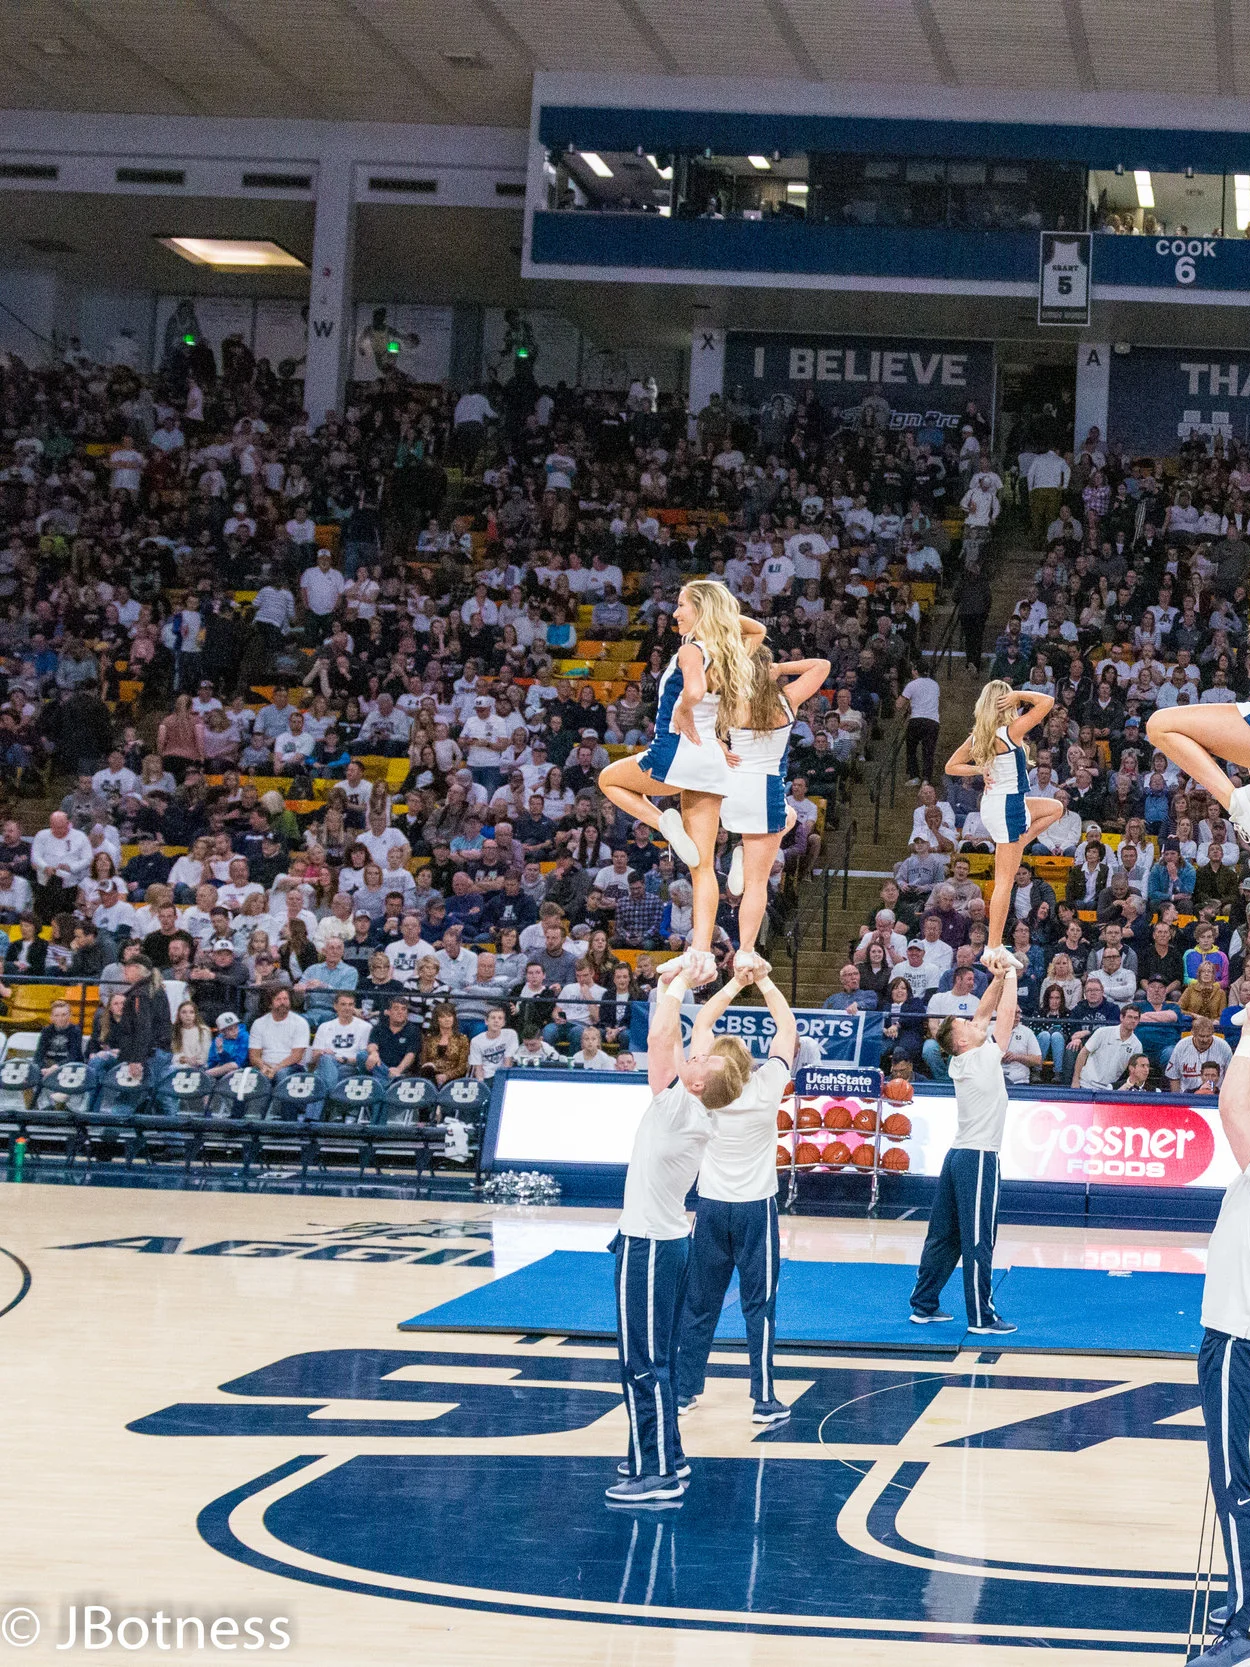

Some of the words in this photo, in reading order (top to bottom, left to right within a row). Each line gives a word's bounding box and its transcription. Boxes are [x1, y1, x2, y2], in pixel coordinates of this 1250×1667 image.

[1155, 240, 1217, 258] COOK
[1174, 256, 1196, 284] 6
[1057, 275, 1072, 295] 5
[314, 321, 334, 338] W
[701, 334, 715, 350] X
[753, 347, 765, 378] I
[788, 347, 969, 386] BELIEVE
[1086, 349, 1102, 367] A
[711, 1015, 756, 1034] CBS
[761, 1016, 854, 1038] SORTS
[805, 1072, 872, 1087] UtahState
[805, 1083, 873, 1094] BASKETBALL
[1022, 1104, 1196, 1177] Gossner
[1066, 1159, 1166, 1178] FOODS
